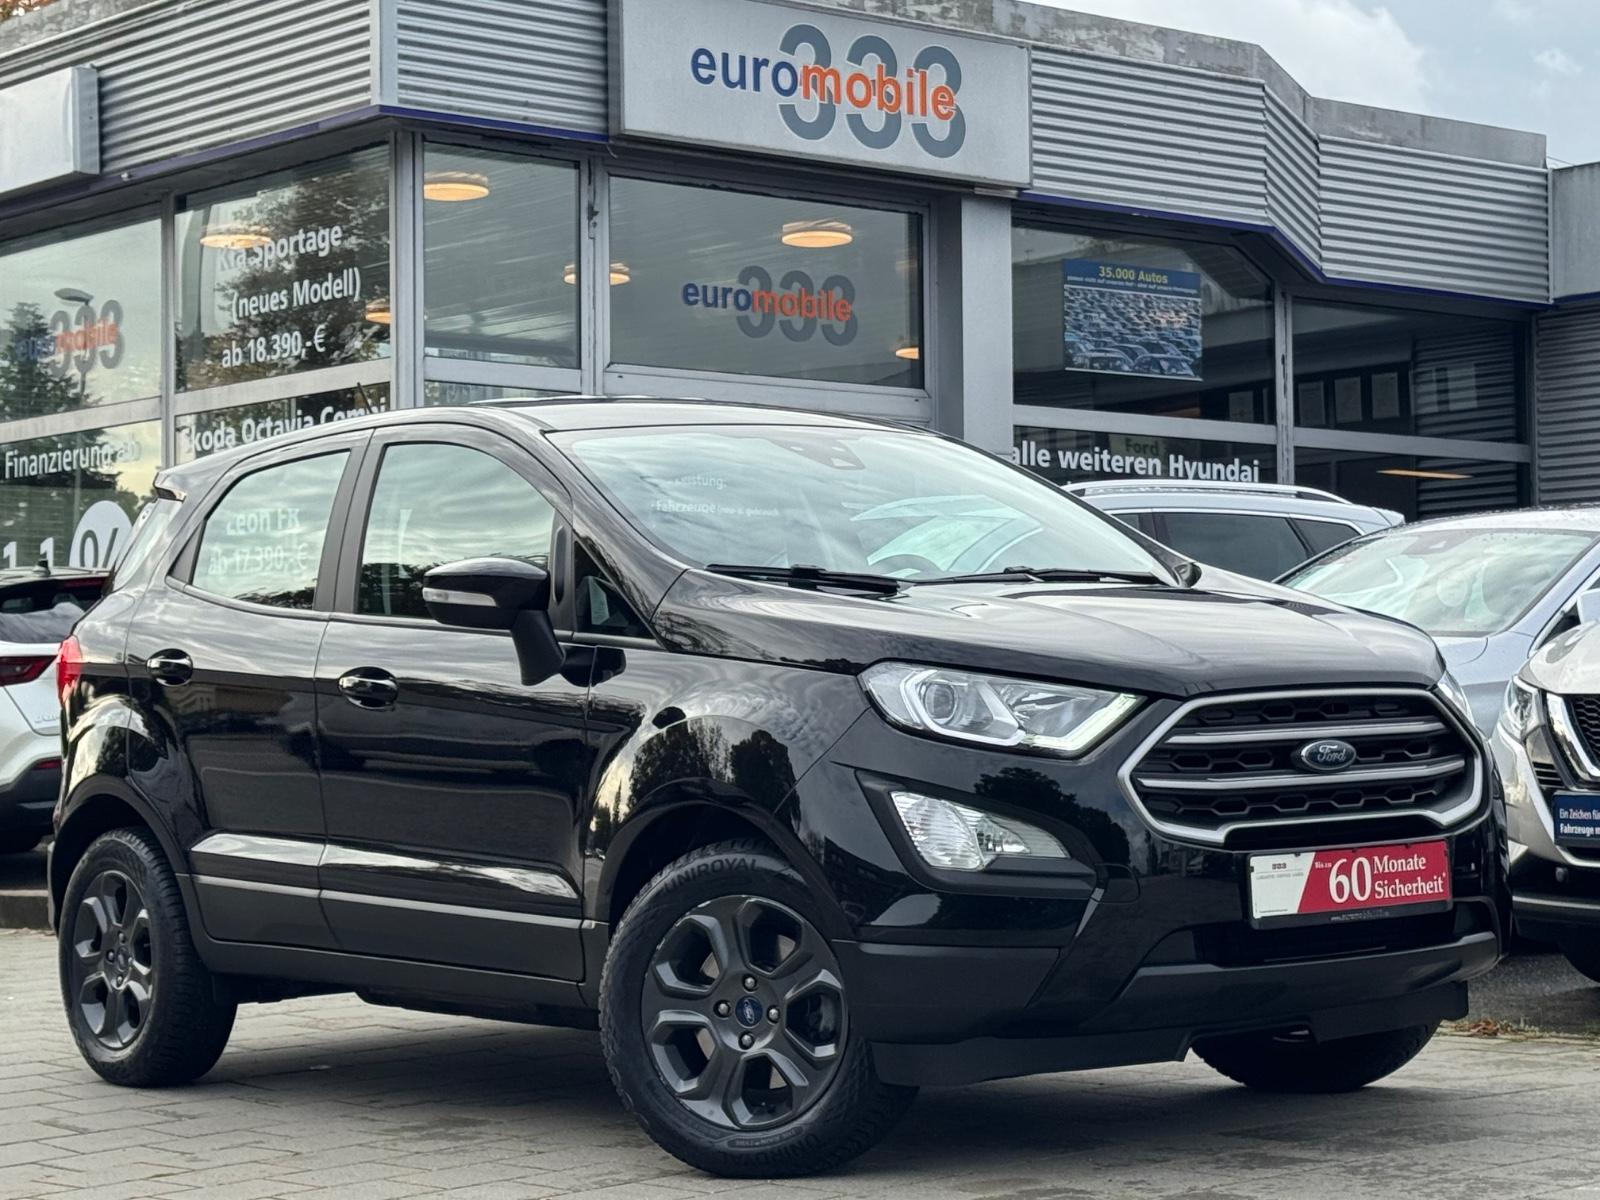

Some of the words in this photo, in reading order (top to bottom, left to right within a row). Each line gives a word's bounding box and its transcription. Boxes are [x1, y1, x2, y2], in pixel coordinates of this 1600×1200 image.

[690, 47, 955, 121] euromobile
[250, 225, 342, 268] Sportage
[1098, 266, 1135, 280] 35.000
[1138, 270, 1168, 285] Autos
[232, 289, 288, 325] (neues
[292, 267, 361, 307] Modell)
[682, 282, 852, 322] euromobile
[222, 341, 242, 368] ab
[5, 442, 113, 480] Finanzierung
[1058, 446, 1161, 476] weiteren
[1169, 454, 1259, 483] Hyundai
[1317, 744, 1346, 762] Ford
[1560, 823, 1594, 837] Fahrzeuge
[1329, 856, 1372, 904] 60
[1373, 854, 1427, 874] Monate
